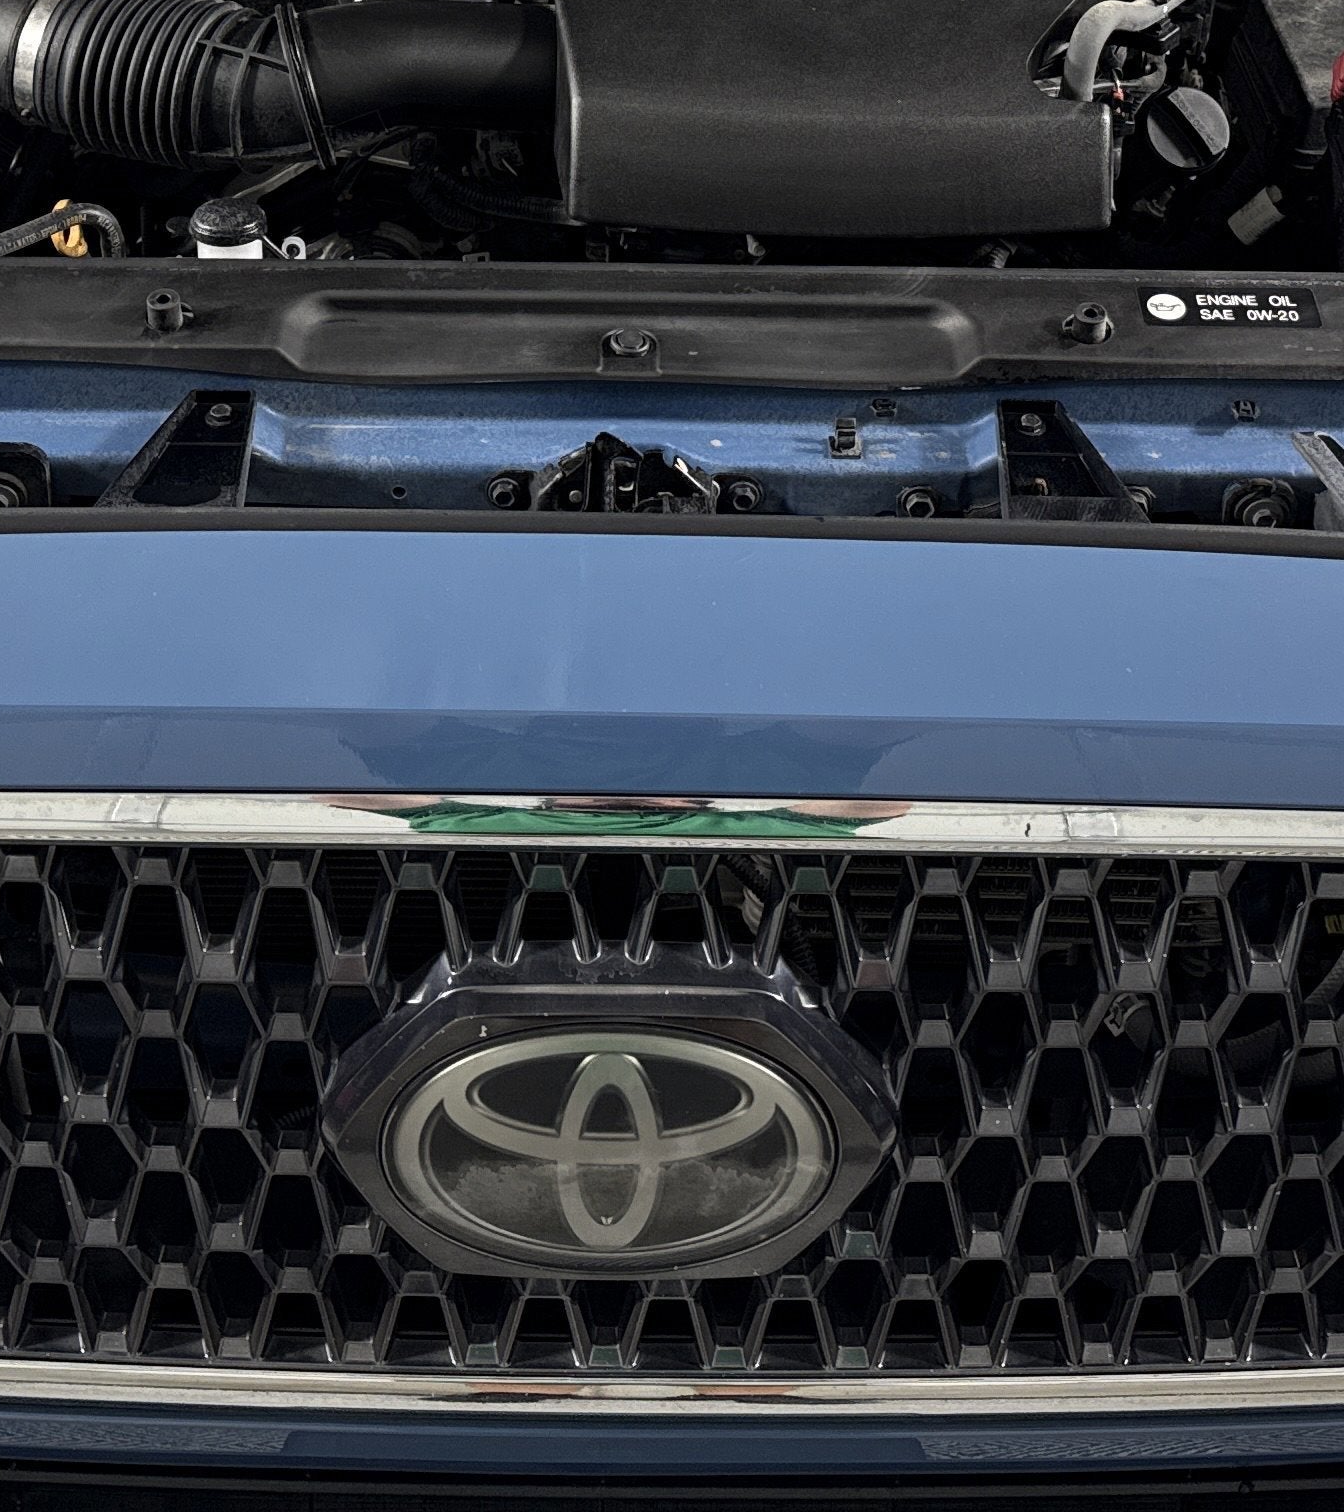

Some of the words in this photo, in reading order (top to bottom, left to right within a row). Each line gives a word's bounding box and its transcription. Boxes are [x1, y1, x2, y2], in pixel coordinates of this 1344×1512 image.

[1195, 294, 1258, 307] ENGINE
[1268, 295, 1298, 307] OIL
[1200, 309, 1235, 321] SAE
[1247, 310, 1300, 322] 0W-20
